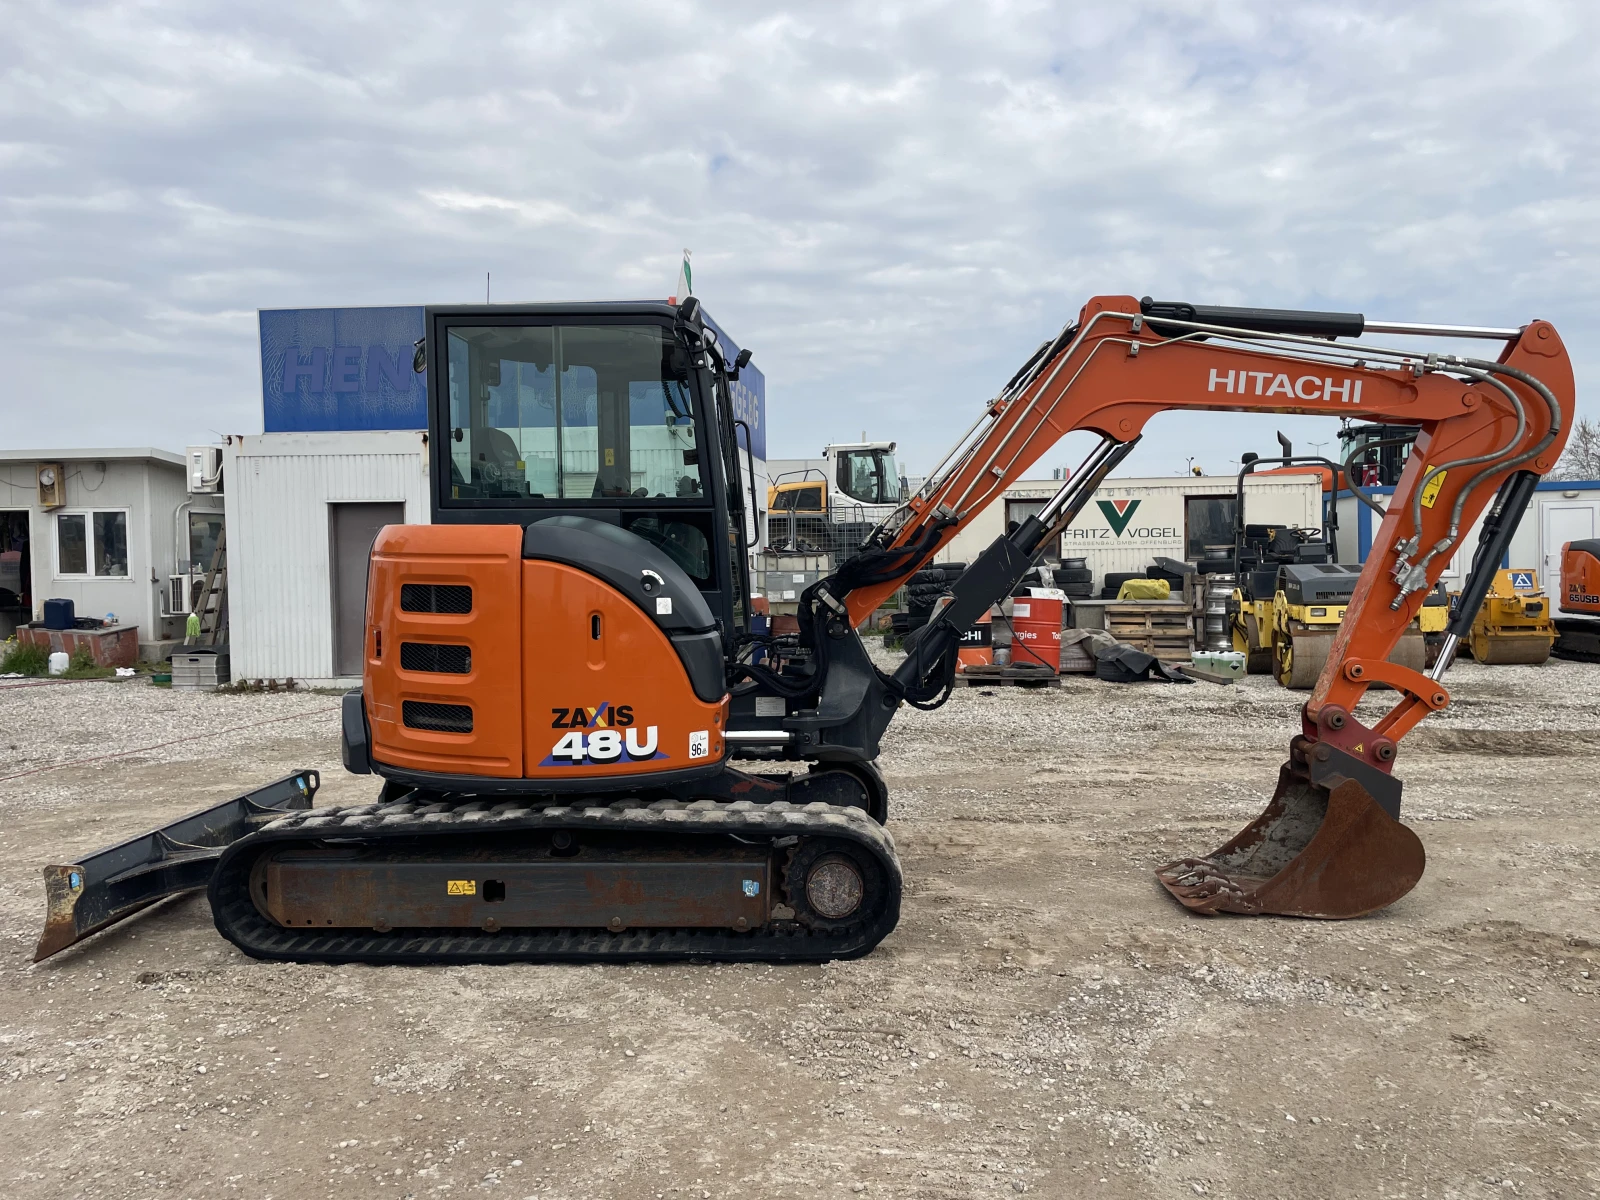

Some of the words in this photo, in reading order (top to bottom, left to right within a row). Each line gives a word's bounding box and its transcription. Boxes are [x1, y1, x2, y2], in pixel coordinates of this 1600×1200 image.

[1207, 368, 1363, 404] HITACHI
[1064, 528, 1110, 539] FRITZ
[1127, 527, 1182, 538] VOGEL
[1569, 594, 1600, 604] 65USB
[552, 702, 634, 729] ZAXIS
[552, 725, 658, 764] 48U
[691, 743, 702, 757] 96
